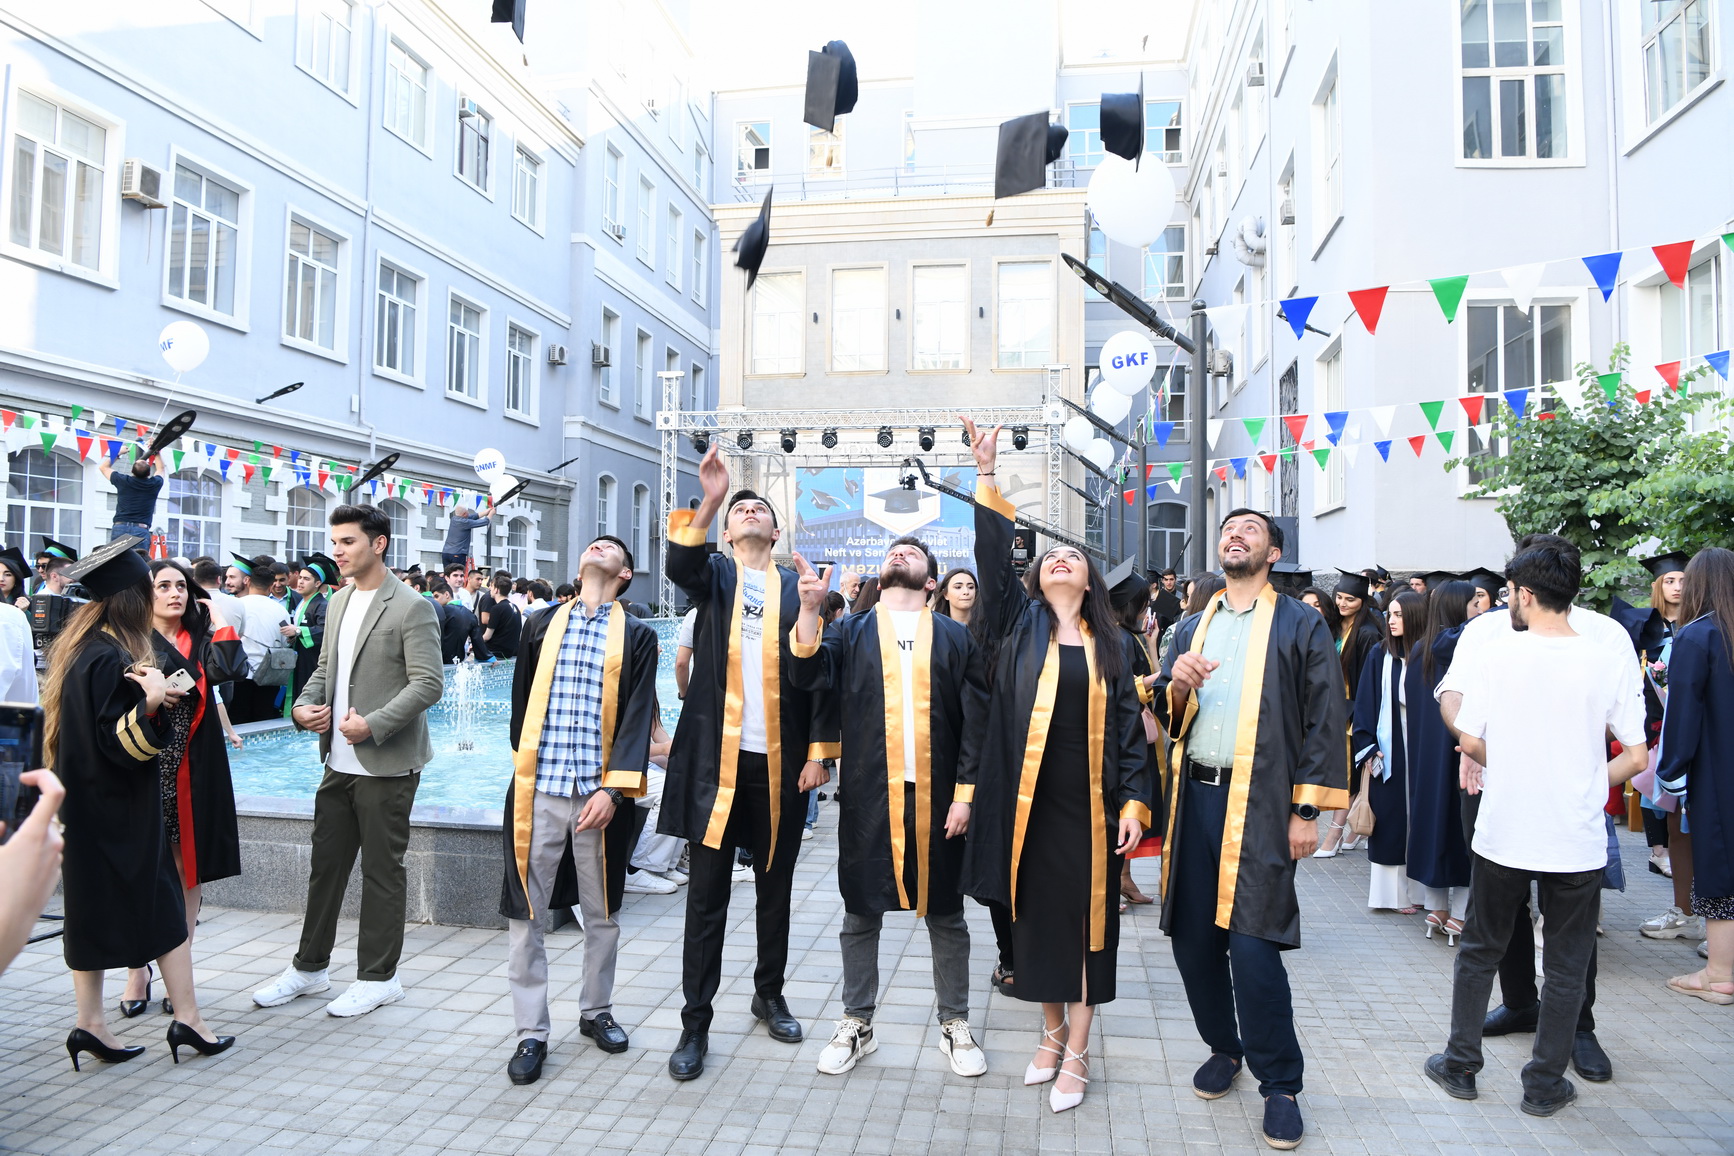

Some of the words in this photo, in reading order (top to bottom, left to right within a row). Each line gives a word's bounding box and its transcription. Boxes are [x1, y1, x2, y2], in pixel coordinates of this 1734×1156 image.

[1111, 351, 1149, 370] GKF
[846, 535, 896, 549] Azərbayc
[824, 547, 847, 557] Neft
[850, 549, 862, 557] və
[864, 547, 886, 557] Sən
[931, 547, 969, 558] ersiteti
